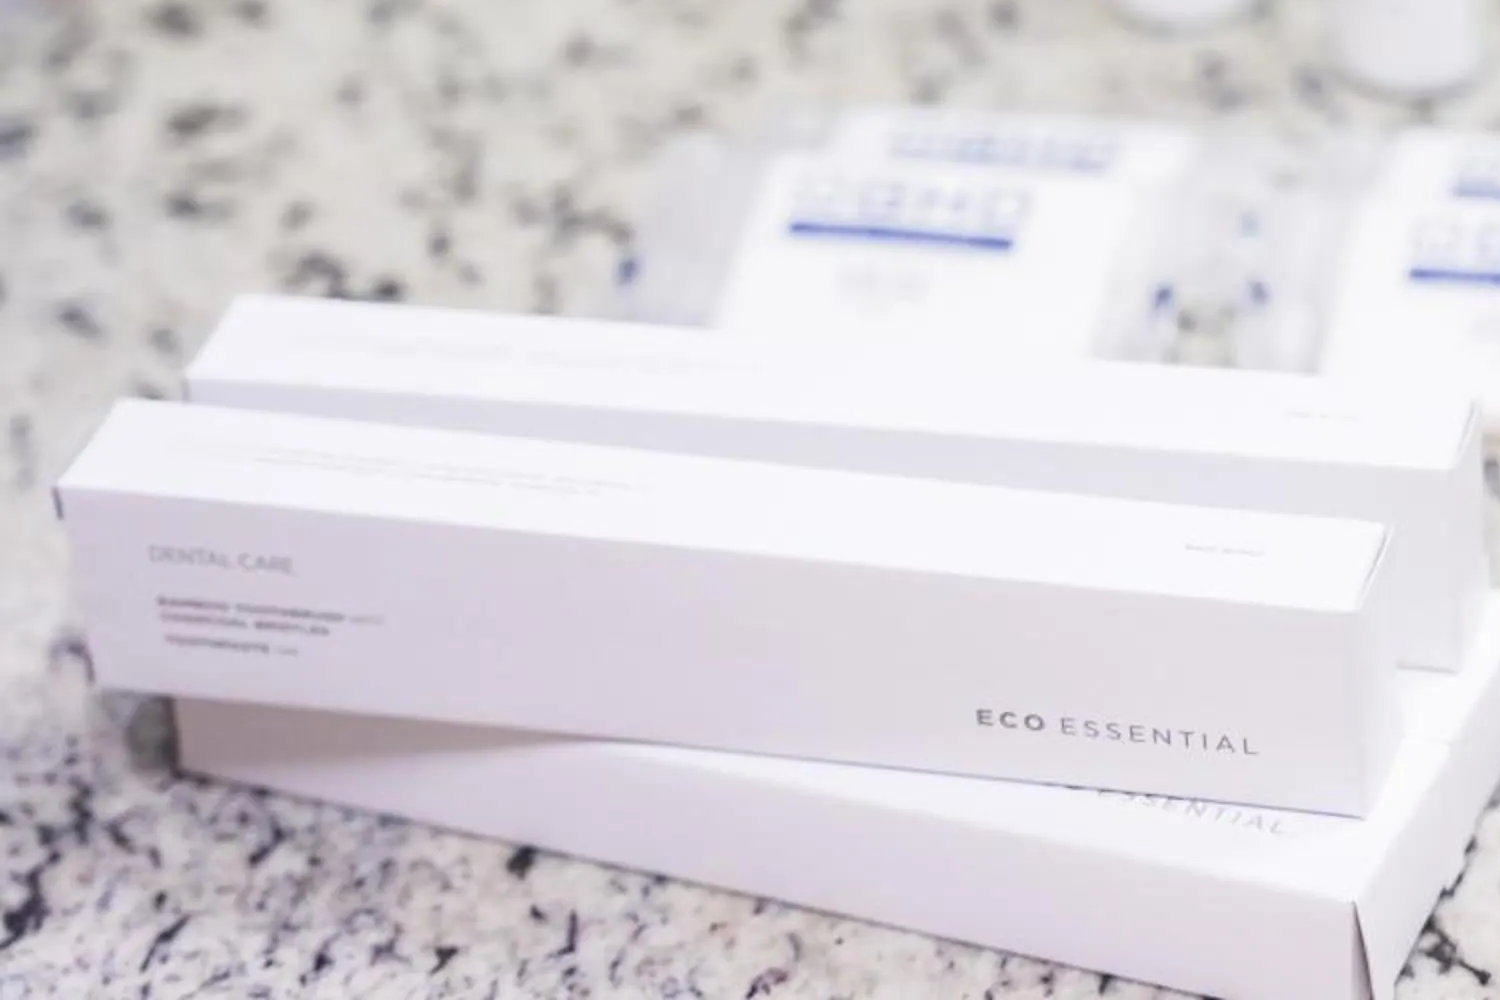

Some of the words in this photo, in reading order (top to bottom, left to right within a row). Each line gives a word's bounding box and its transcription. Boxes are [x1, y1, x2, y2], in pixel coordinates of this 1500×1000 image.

[148, 545, 230, 570] DENTAL
[237, 551, 294, 575] CARE
[976, 708, 1046, 732] ECO
[1060, 716, 1259, 756] ESSENTIAL
